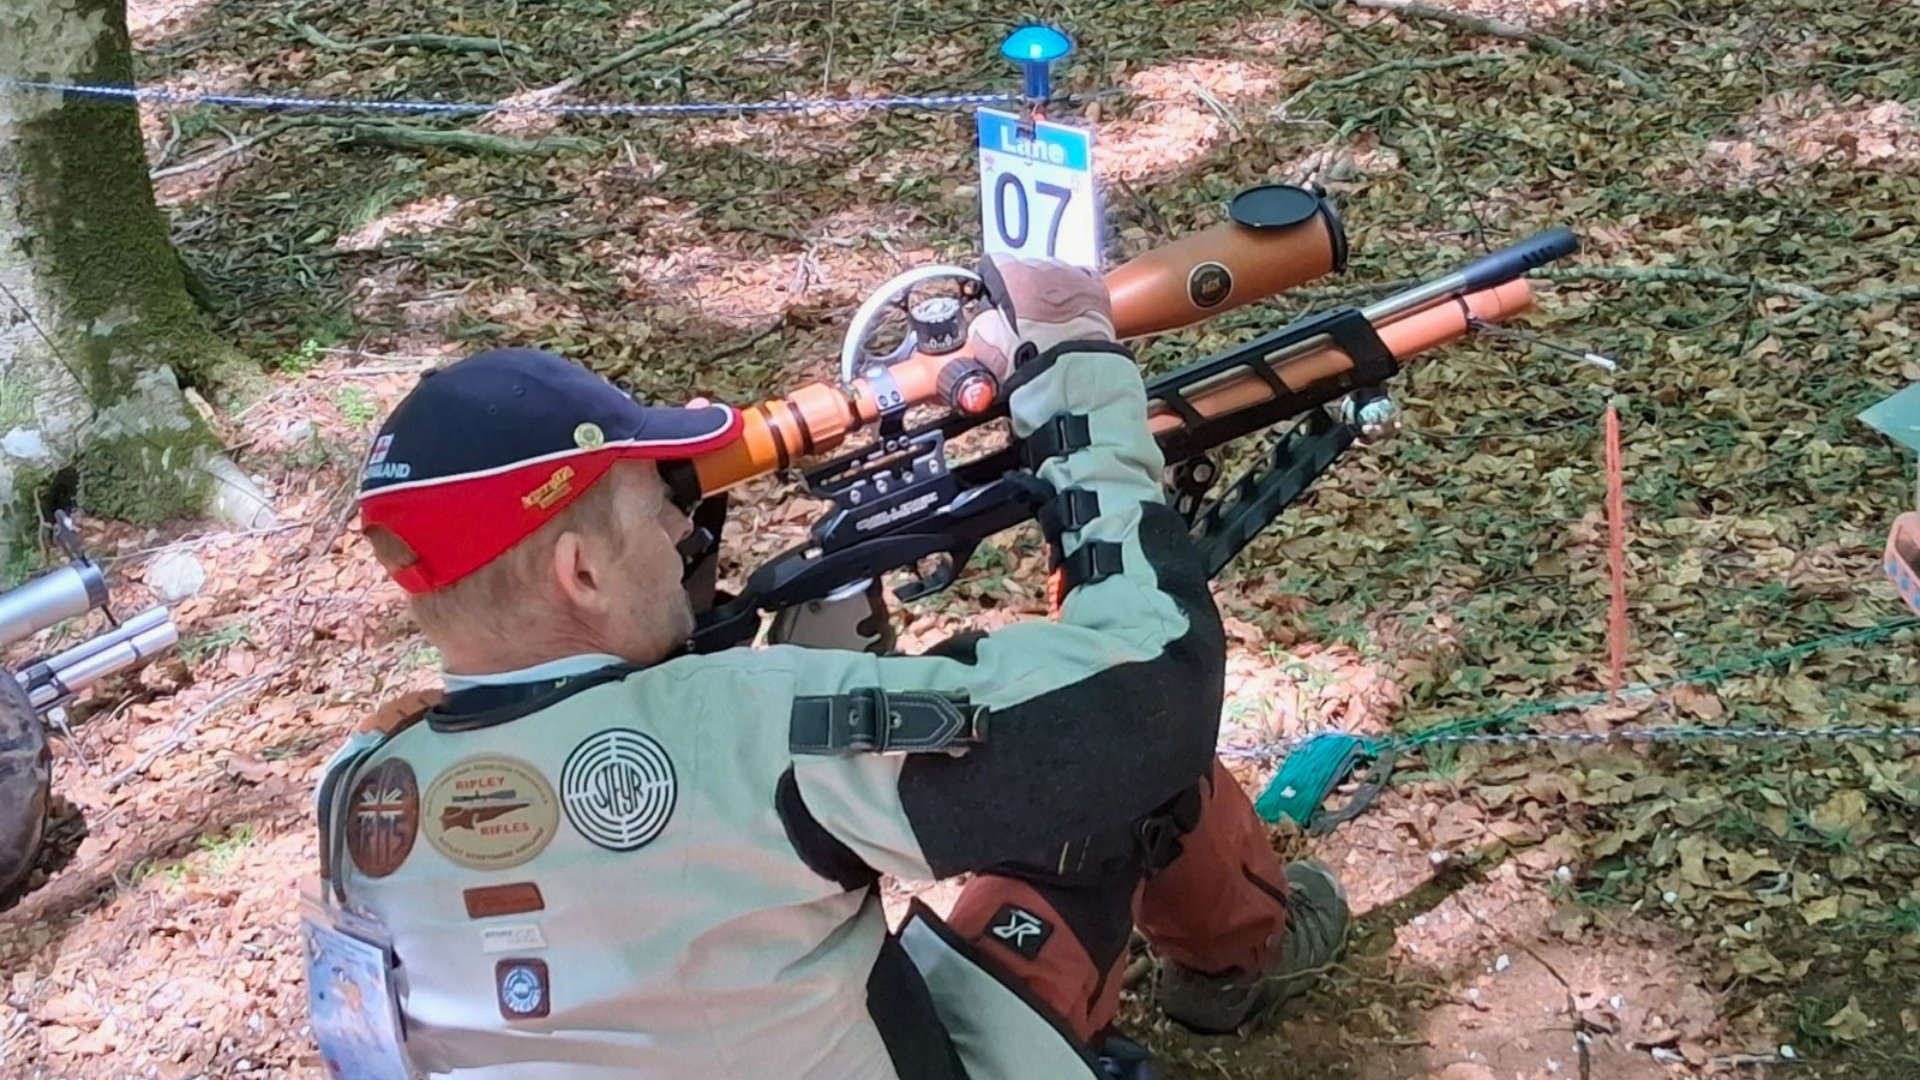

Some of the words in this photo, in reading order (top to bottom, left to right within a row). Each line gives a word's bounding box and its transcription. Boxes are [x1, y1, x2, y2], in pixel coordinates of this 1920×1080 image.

[1000, 125, 1065, 164] Lane
[994, 172, 1072, 257] 07
[455, 776, 505, 791] RIPLEY
[593, 762, 644, 817] STEYR
[479, 822, 531, 836] RIFLES
